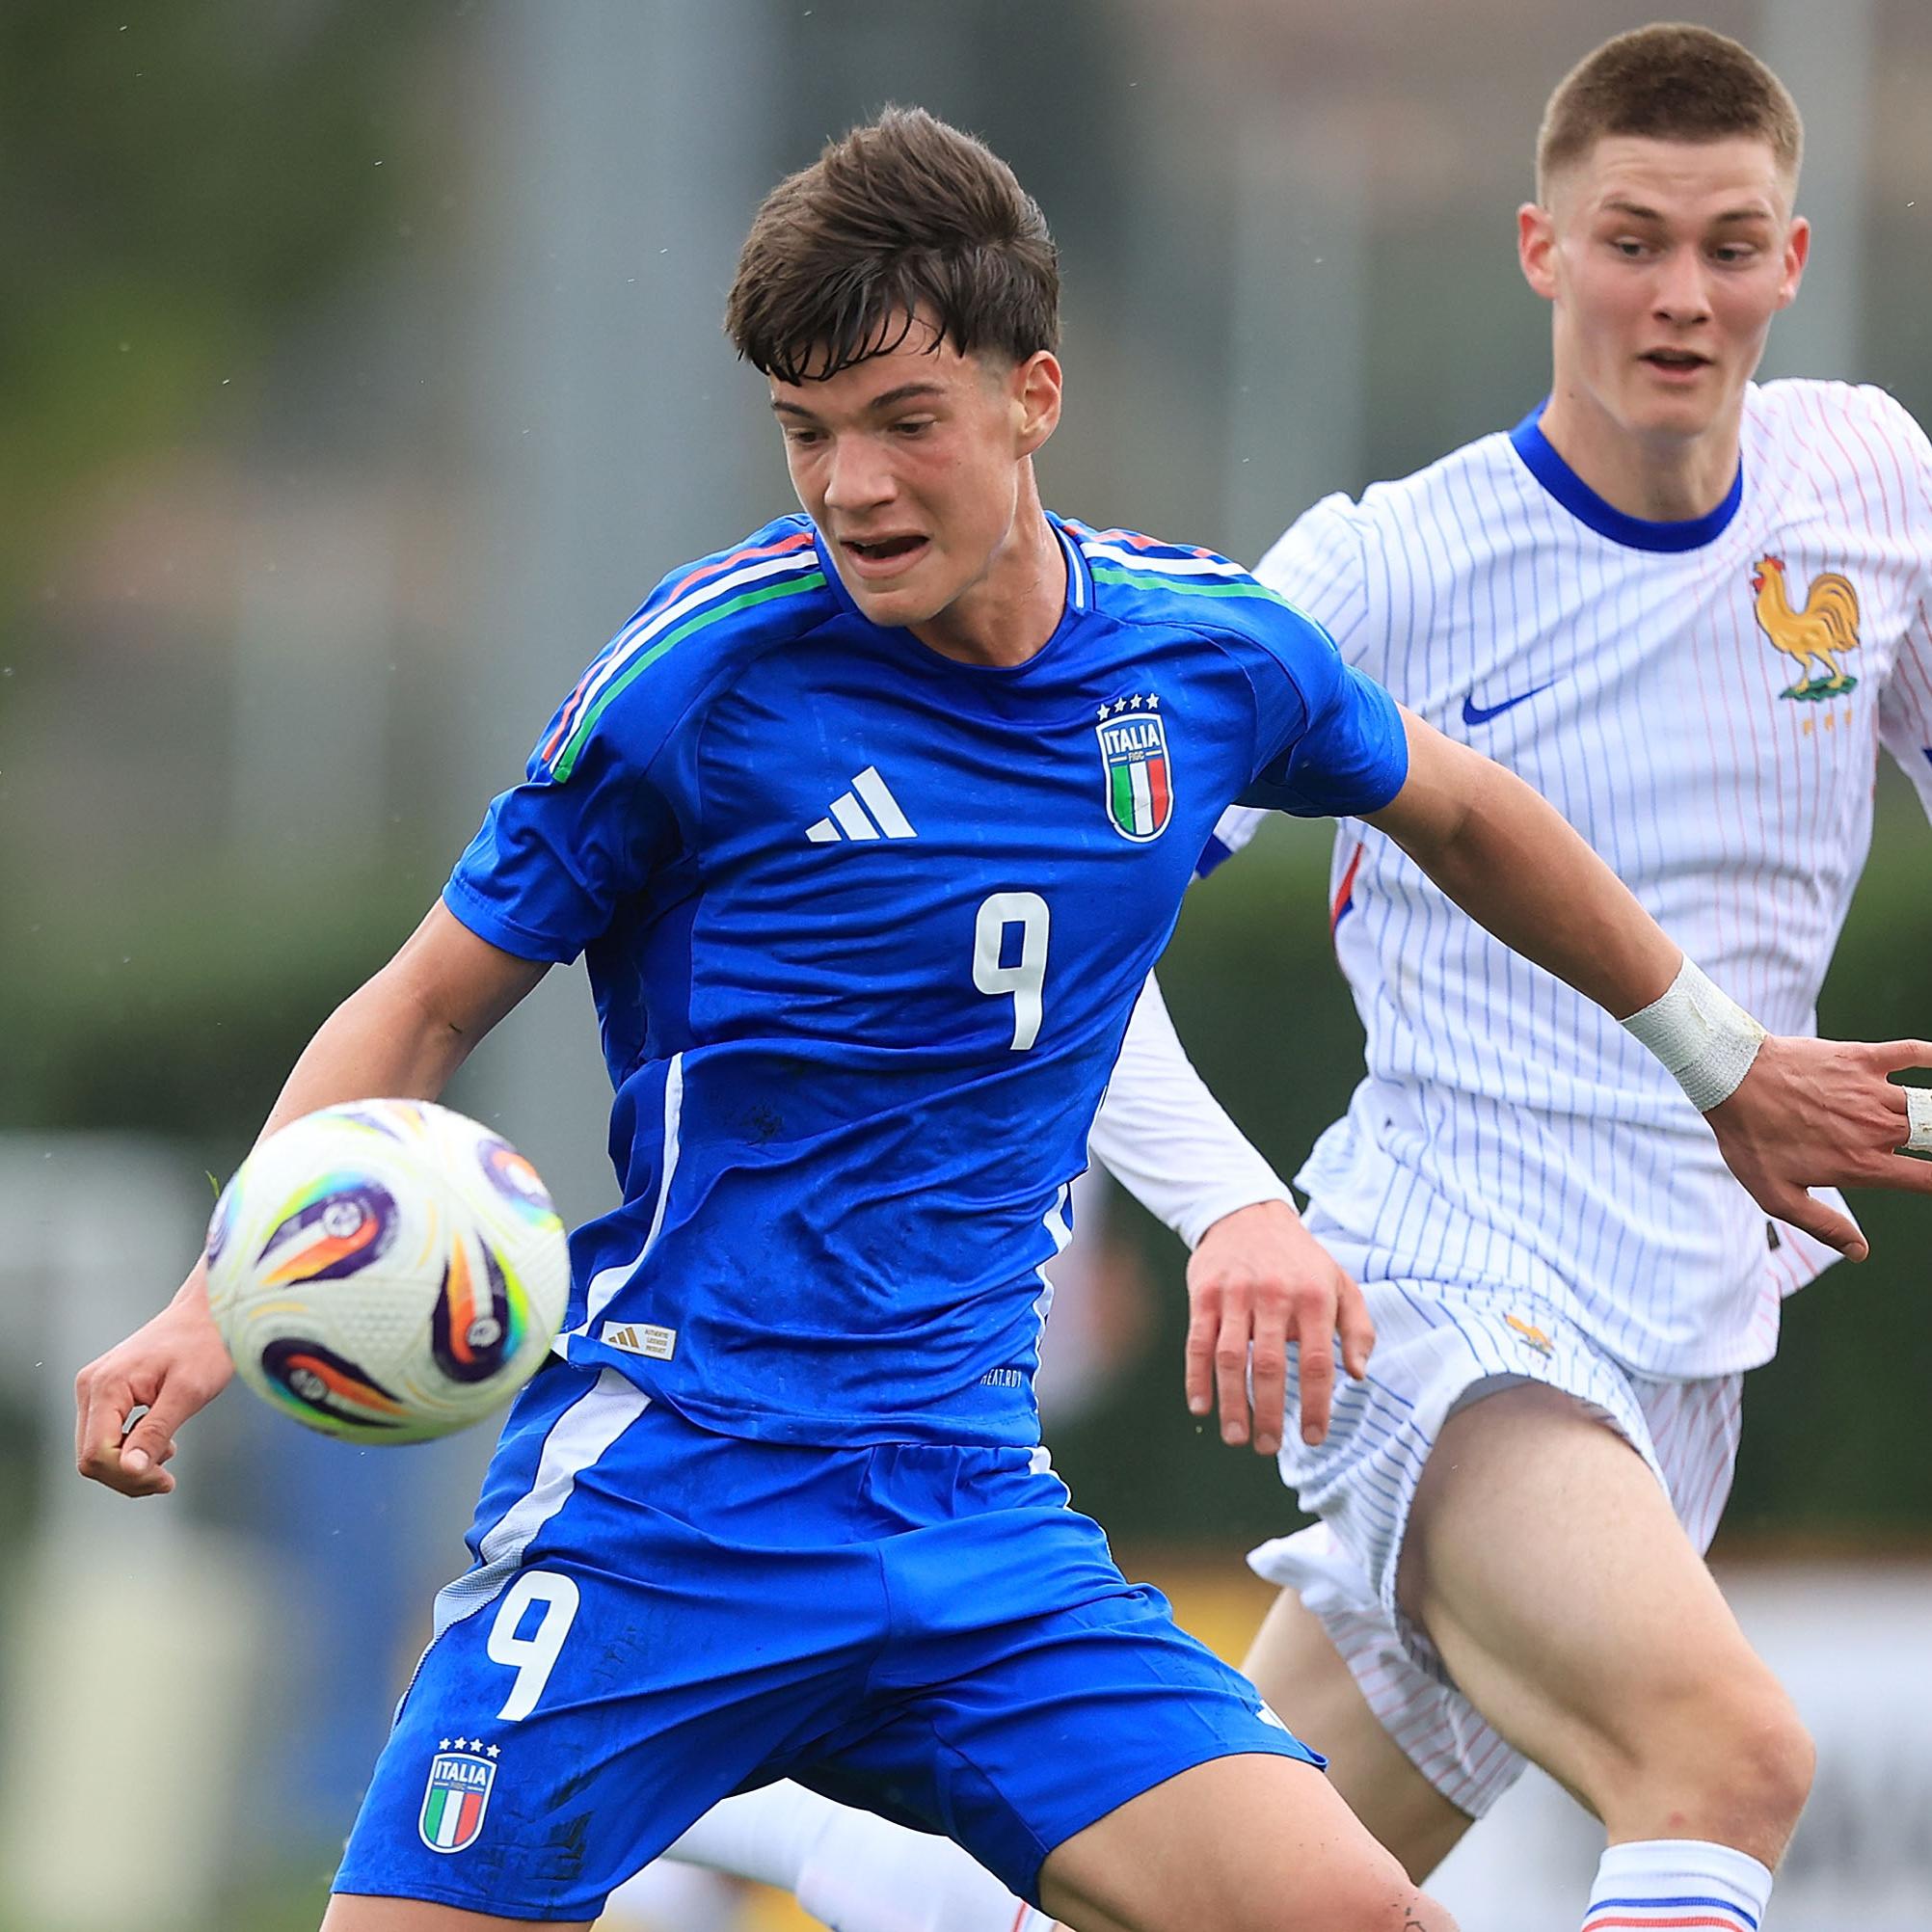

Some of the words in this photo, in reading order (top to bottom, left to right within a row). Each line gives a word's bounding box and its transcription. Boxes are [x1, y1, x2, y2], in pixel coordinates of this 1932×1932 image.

[1103, 723, 1161, 755] ITALIA
[973, 892, 1050, 1050] 9
[487, 1570, 580, 1722] 9
[434, 1760, 487, 1786] ITALIA
